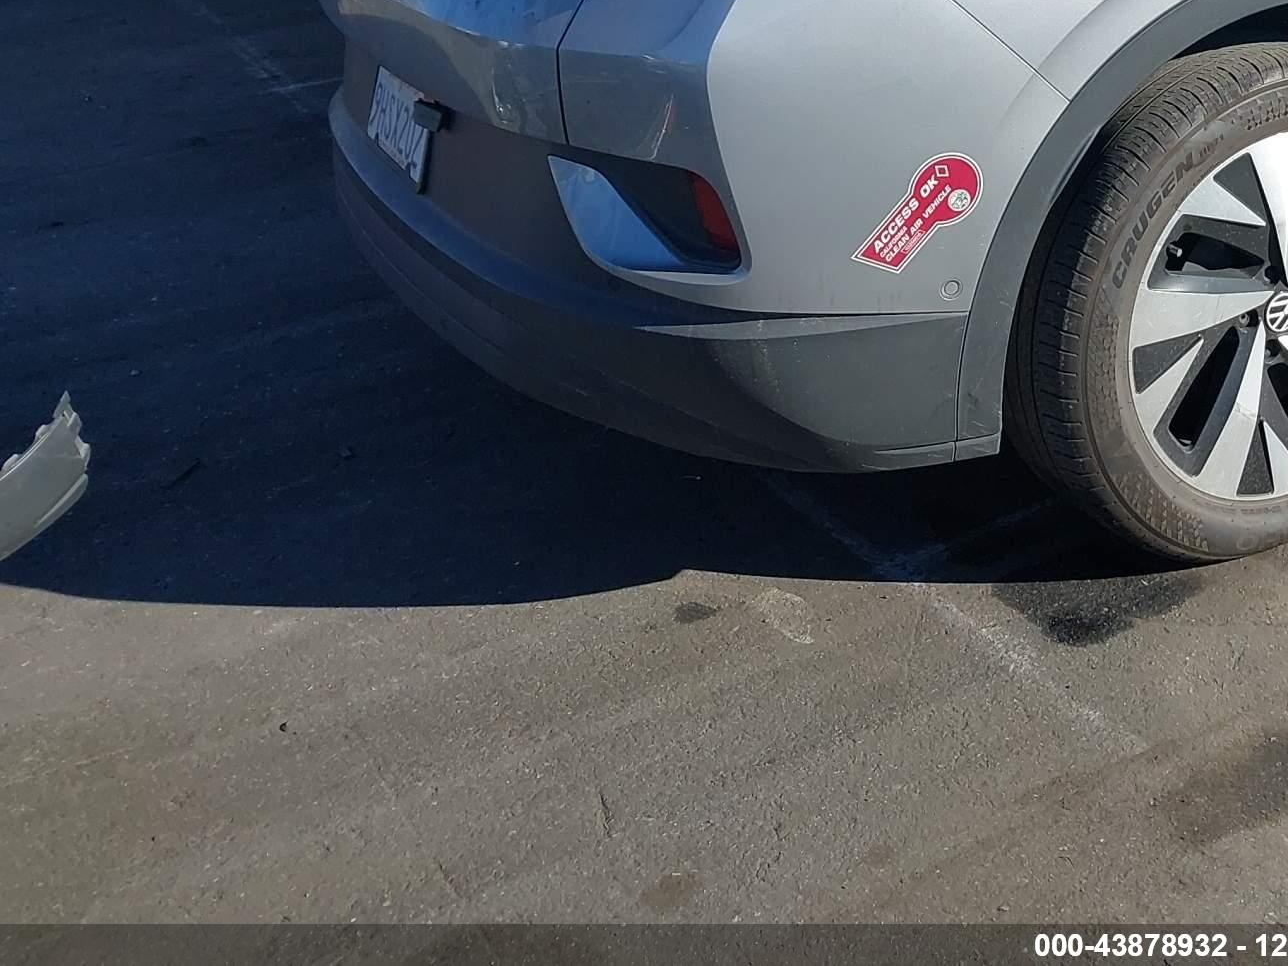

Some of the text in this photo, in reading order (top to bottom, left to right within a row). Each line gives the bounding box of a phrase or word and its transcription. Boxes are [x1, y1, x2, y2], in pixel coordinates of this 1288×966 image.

[873, 197, 919, 253] ACCESS
[919, 174, 939, 198] OK
[880, 226, 908, 258] CALIFORNIA
[885, 233, 910, 262] CLEAN
[909, 219, 924, 235] AIR
[922, 184, 952, 219] VEHICLE
